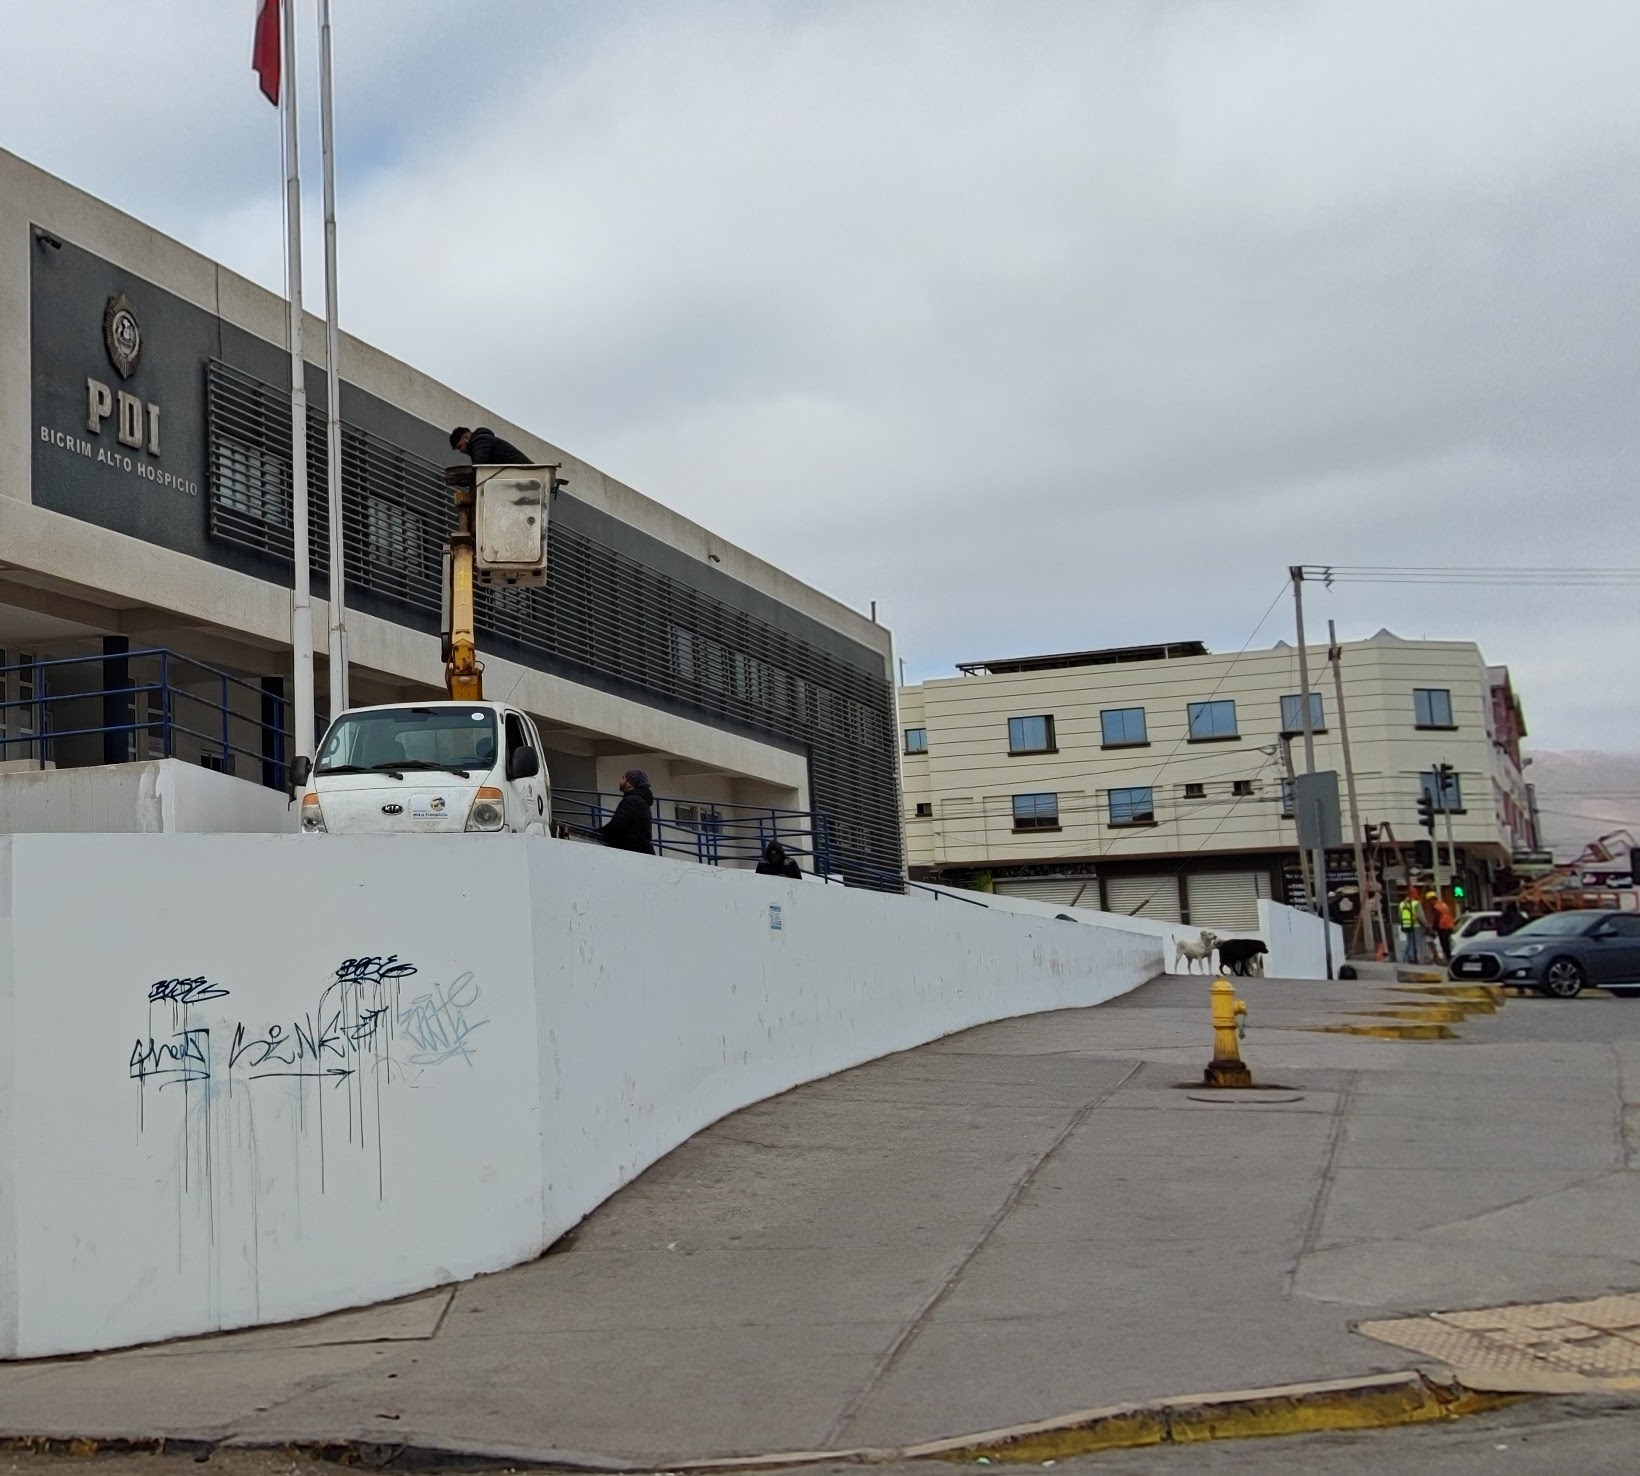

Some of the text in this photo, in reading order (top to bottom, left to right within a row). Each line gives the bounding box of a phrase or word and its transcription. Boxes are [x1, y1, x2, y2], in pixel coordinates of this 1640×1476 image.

[85, 377, 160, 457] PDI
[40, 426, 198, 496] BICRIM ALTO HOSPICIO
